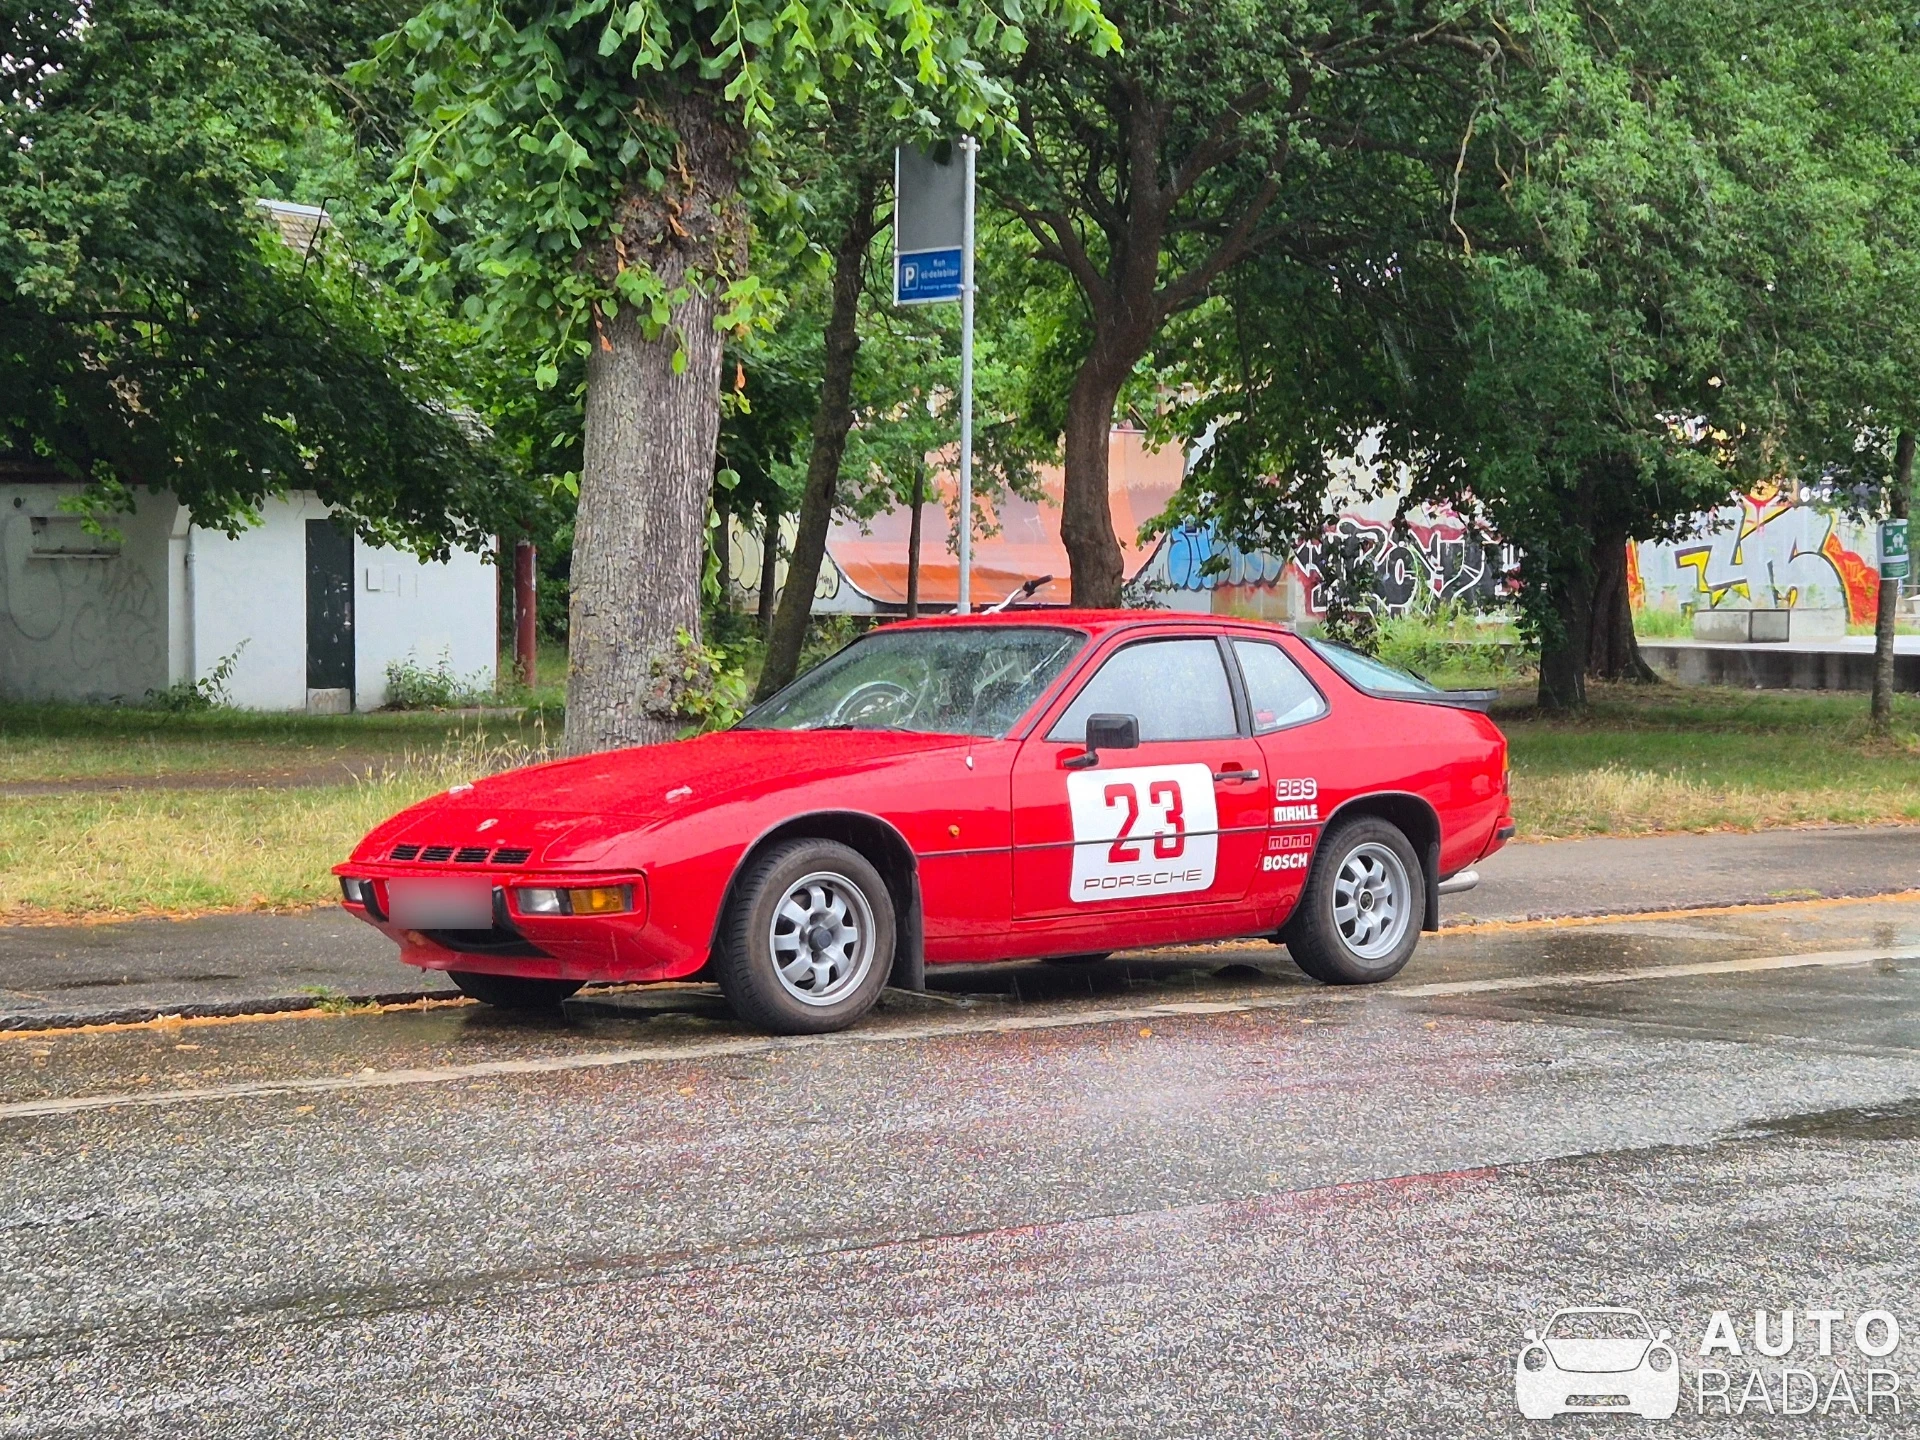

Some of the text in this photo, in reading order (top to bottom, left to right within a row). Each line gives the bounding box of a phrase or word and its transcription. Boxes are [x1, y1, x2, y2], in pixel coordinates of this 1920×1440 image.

[905, 267, 915, 287] P
[1277, 779, 1316, 799] BBS
[1104, 780, 1186, 863] 23
[1274, 804, 1318, 822] MAHLE
[1263, 852, 1308, 871] BOSCH
[1083, 869, 1203, 891] PORSCHE
